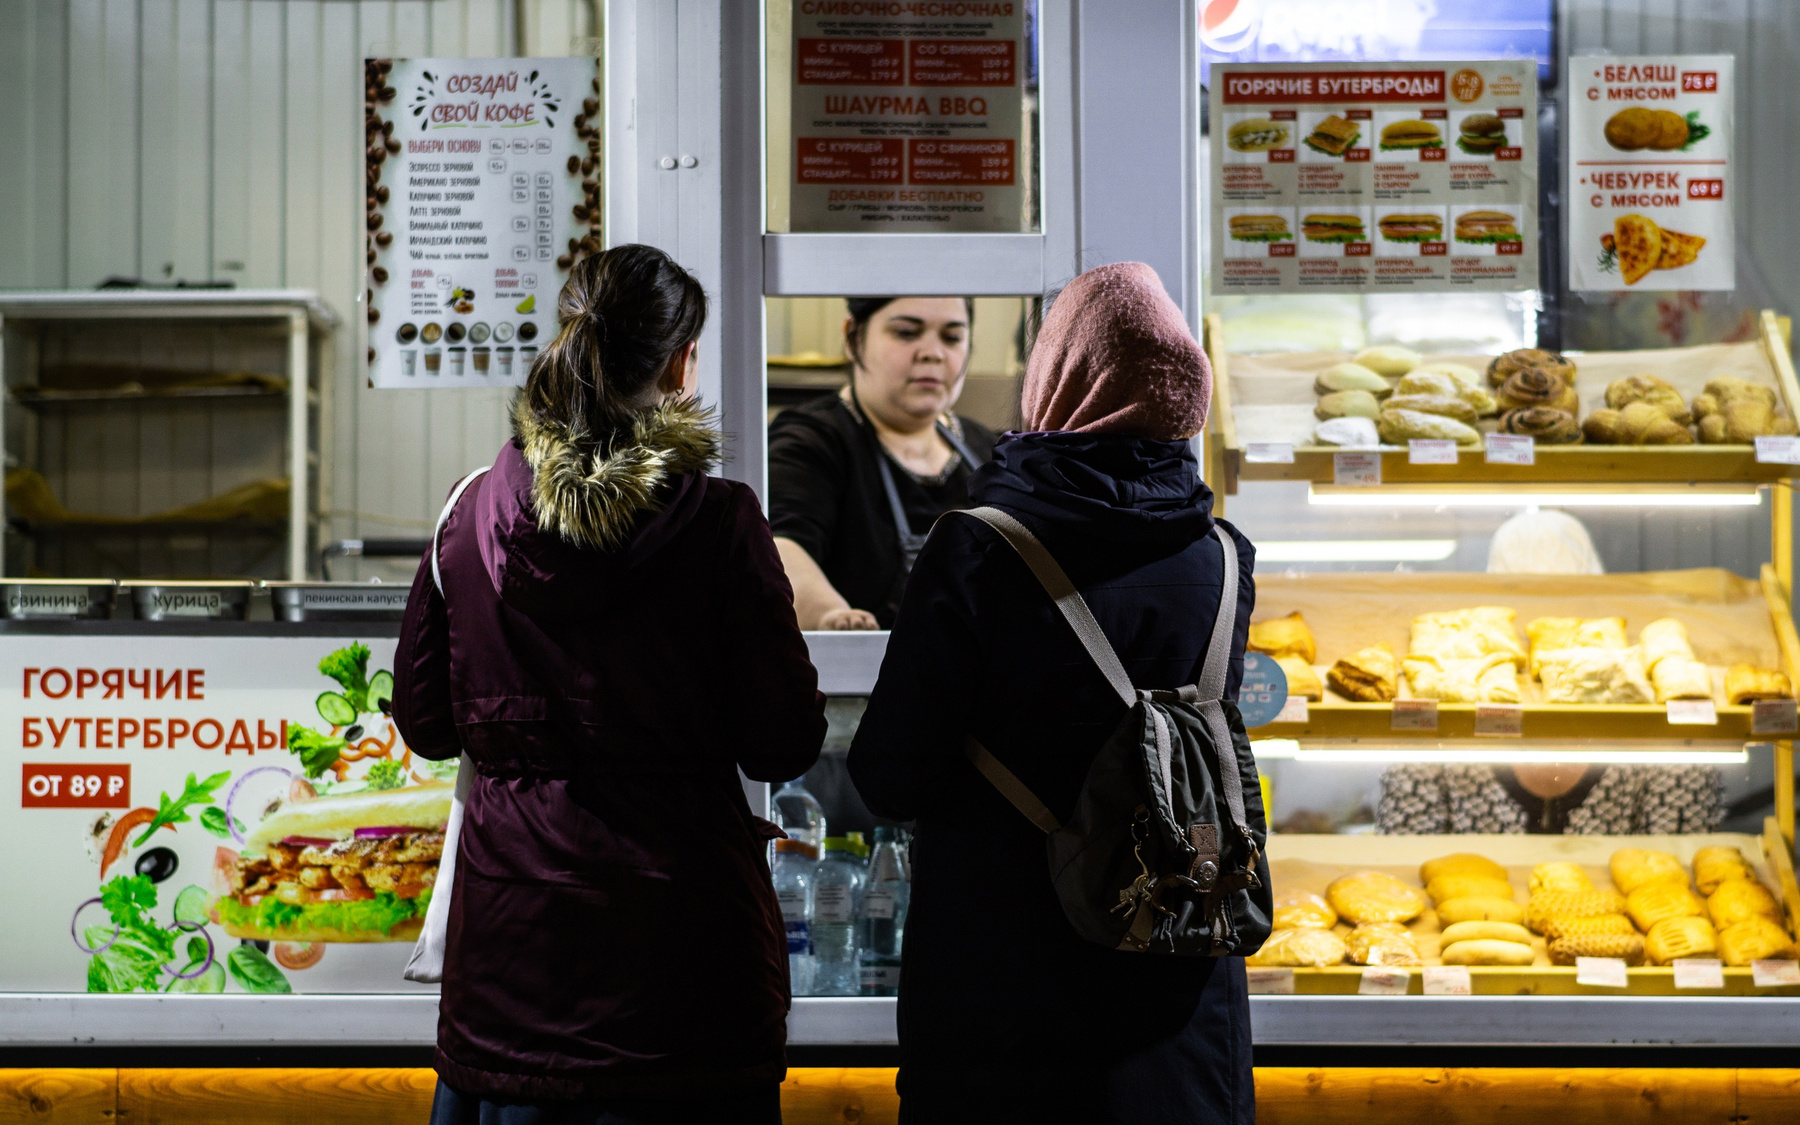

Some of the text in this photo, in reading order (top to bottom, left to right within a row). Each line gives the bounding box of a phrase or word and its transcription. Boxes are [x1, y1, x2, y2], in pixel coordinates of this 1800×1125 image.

[801, 2, 1014, 18] СЛИВОЧНО-ЧЕСНОЧНАЯ
[1604, 65, 1676, 83] БЕЛЯШ
[446, 71, 519, 99] СОЗДАЙ
[1228, 77, 1440, 97] ГОРЯЧИЕ БУТЕРБРОДЫ
[1684, 76, 1701, 89] 75
[1587, 87, 1676, 101] С МЯСОМ
[431, 101, 535, 123] СВОЙ КОФЕ
[824, 96, 988, 116] ШАУРМА BBQ
[408, 139, 444, 153] ВЫБЕРИ
[447, 139, 482, 153] ОСНОВУ
[1590, 172, 1680, 189] ЧЕБУРЕК
[828, 190, 984, 203] ДОБАВКИ БЕСПЛАТНО
[1690, 183, 1707, 196] 69
[1590, 195, 1680, 208] С МЯСОМ
[409, 206, 428, 217] ЛАТТЕ
[409, 250, 424, 260] ЧАЙ
[10, 594, 88, 608] свинина
[152, 594, 219, 611] курица
[305, 594, 408, 606] пекинская капуста
[22, 667, 205, 700] ГОРЯЧИЕ
[22, 717, 288, 755] БУТЕРБРОДЫ
[29, 775, 63, 797] ОТ
[71, 775, 101, 797] 89
